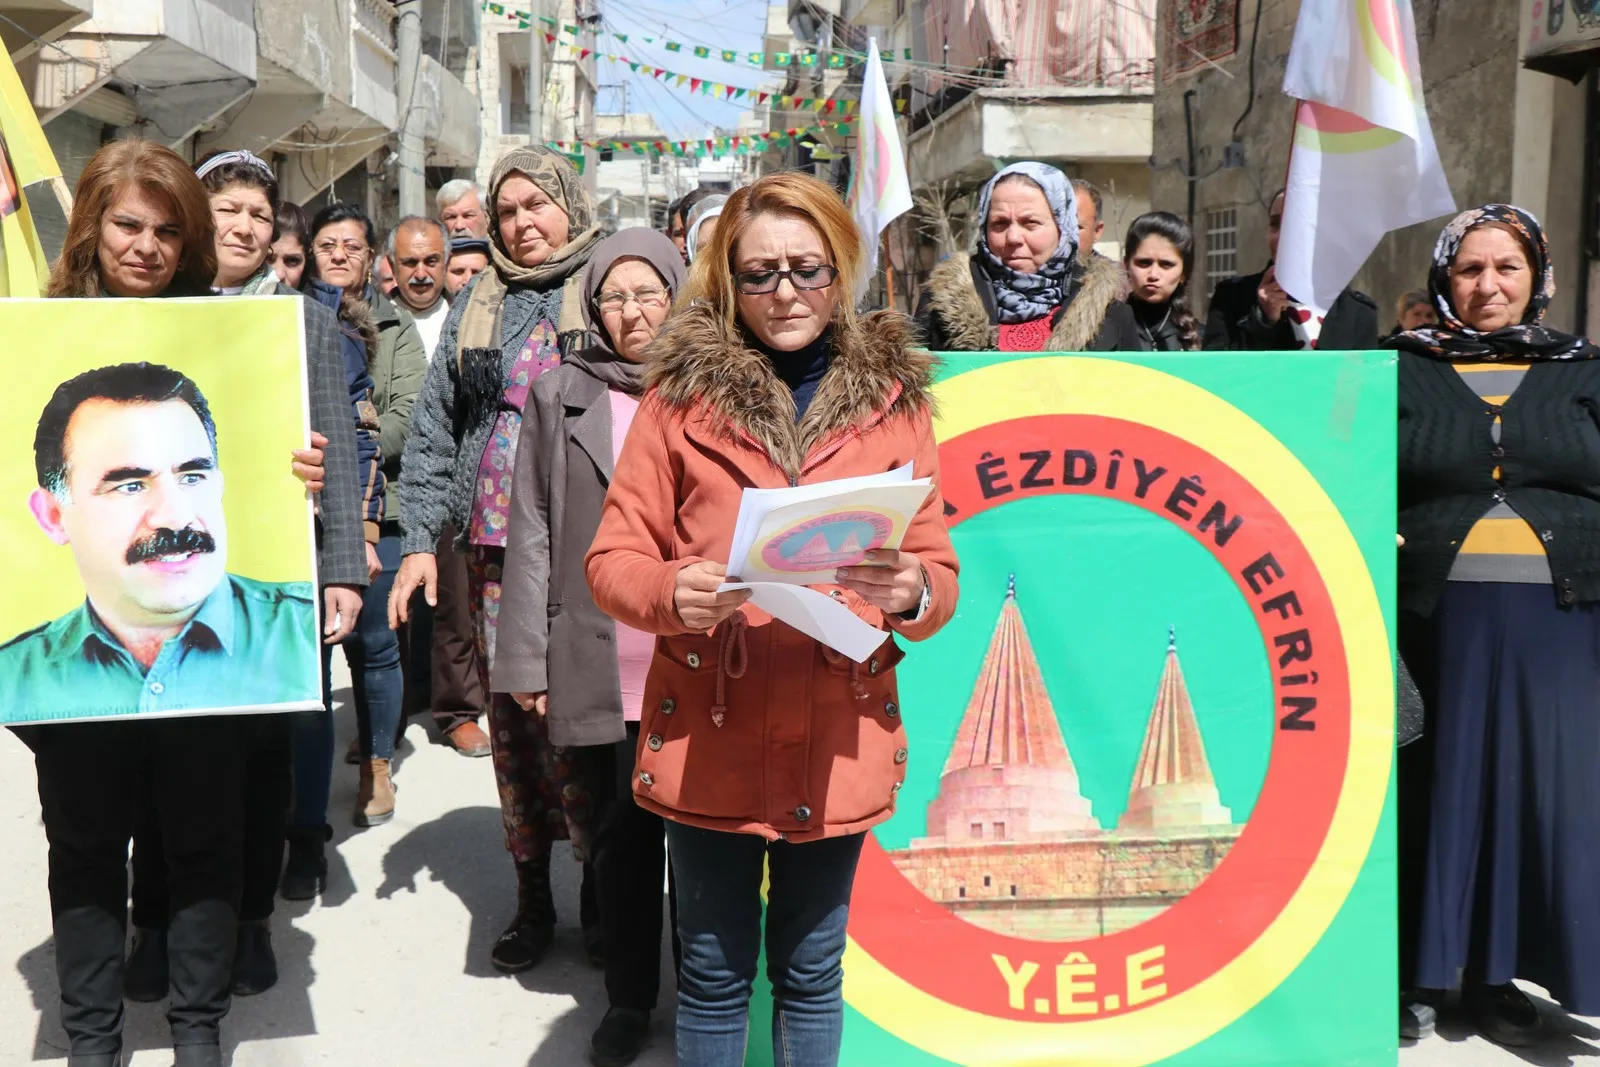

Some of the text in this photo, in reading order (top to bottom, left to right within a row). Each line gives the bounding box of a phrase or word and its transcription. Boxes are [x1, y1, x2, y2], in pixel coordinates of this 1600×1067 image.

[975, 449, 1318, 731] ÊZDÎYÊN EFRÎN
[991, 944, 1168, 1016] Y.Ê.E
